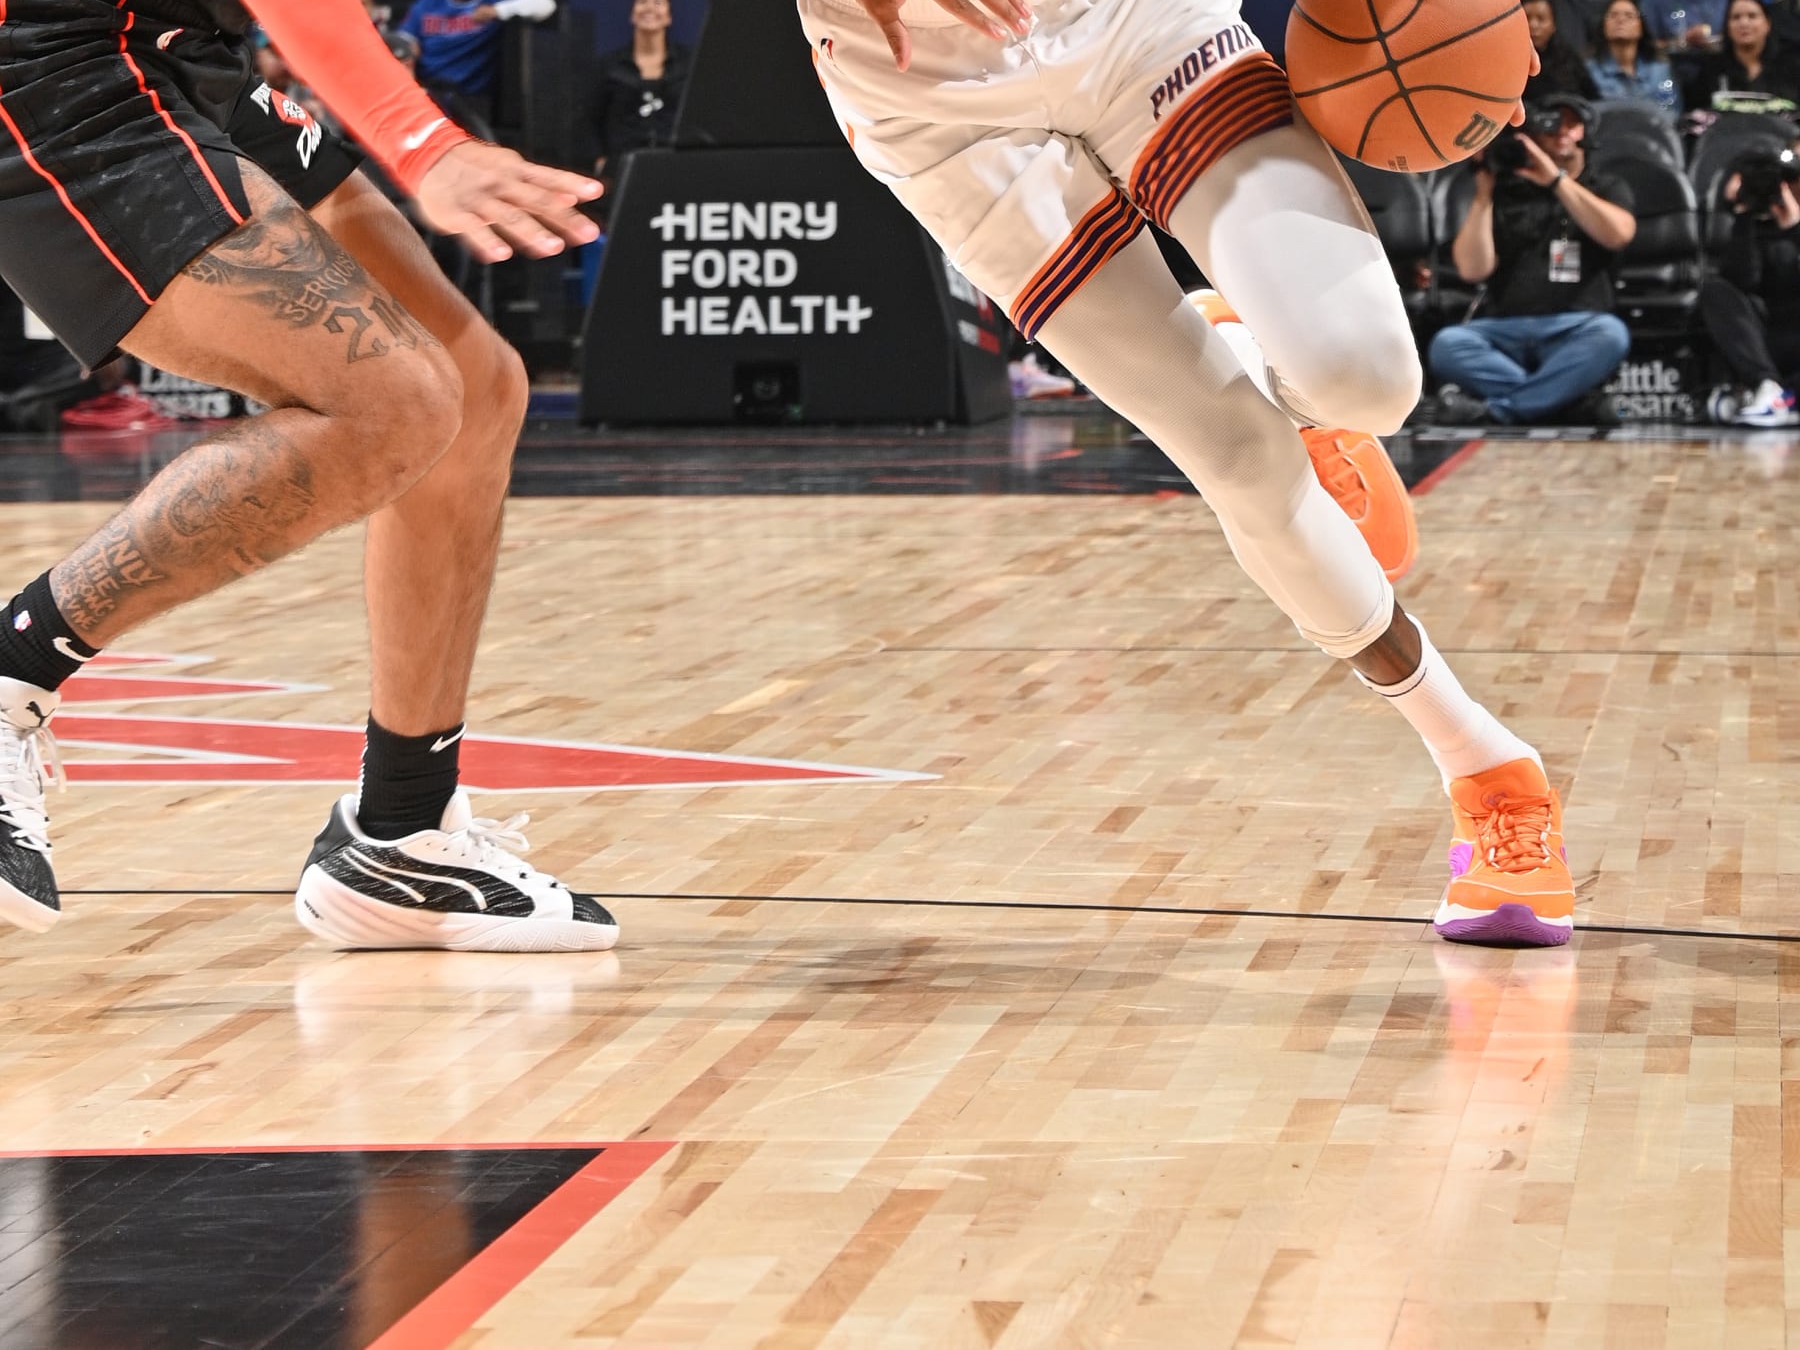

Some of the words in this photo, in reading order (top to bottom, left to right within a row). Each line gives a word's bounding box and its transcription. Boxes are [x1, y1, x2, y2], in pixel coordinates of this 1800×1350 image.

[1150, 24, 1255, 122] PHOENIX
[650, 201, 838, 242] HENRY
[661, 249, 799, 289] FORD
[661, 295, 874, 336] HEALTH
